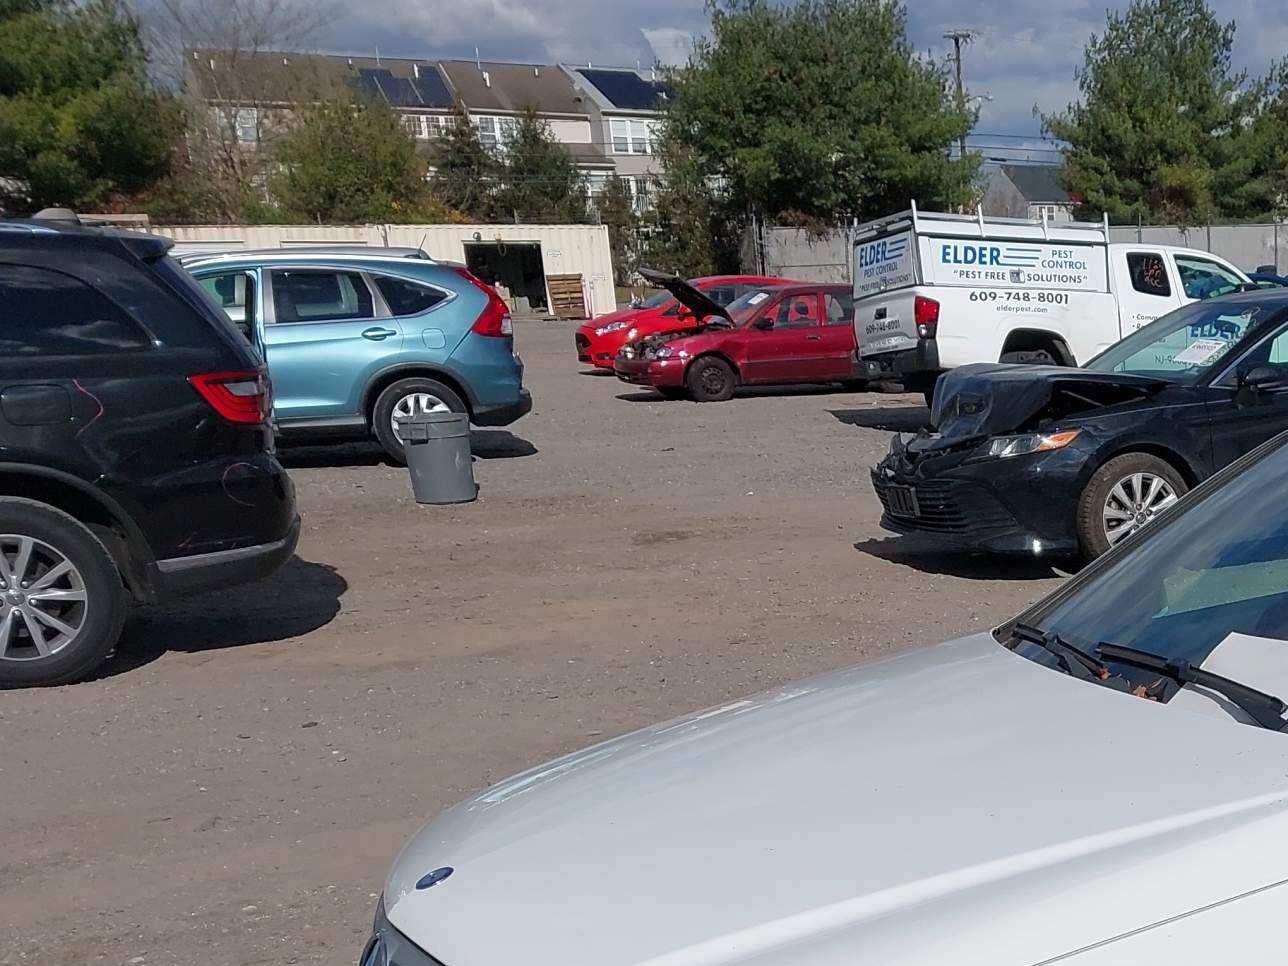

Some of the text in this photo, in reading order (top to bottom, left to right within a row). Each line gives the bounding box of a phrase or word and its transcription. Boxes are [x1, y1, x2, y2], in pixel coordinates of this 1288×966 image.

[860, 241, 888, 268] ELDER
[941, 244, 1001, 266] ELDER
[1051, 249, 1073, 259] PEST
[864, 261, 898, 279] PEST CONTROL
[1041, 259, 1088, 270] CONTROL
[985, 271, 1006, 281] FREE
[969, 291, 1069, 304] 609-748-8001
